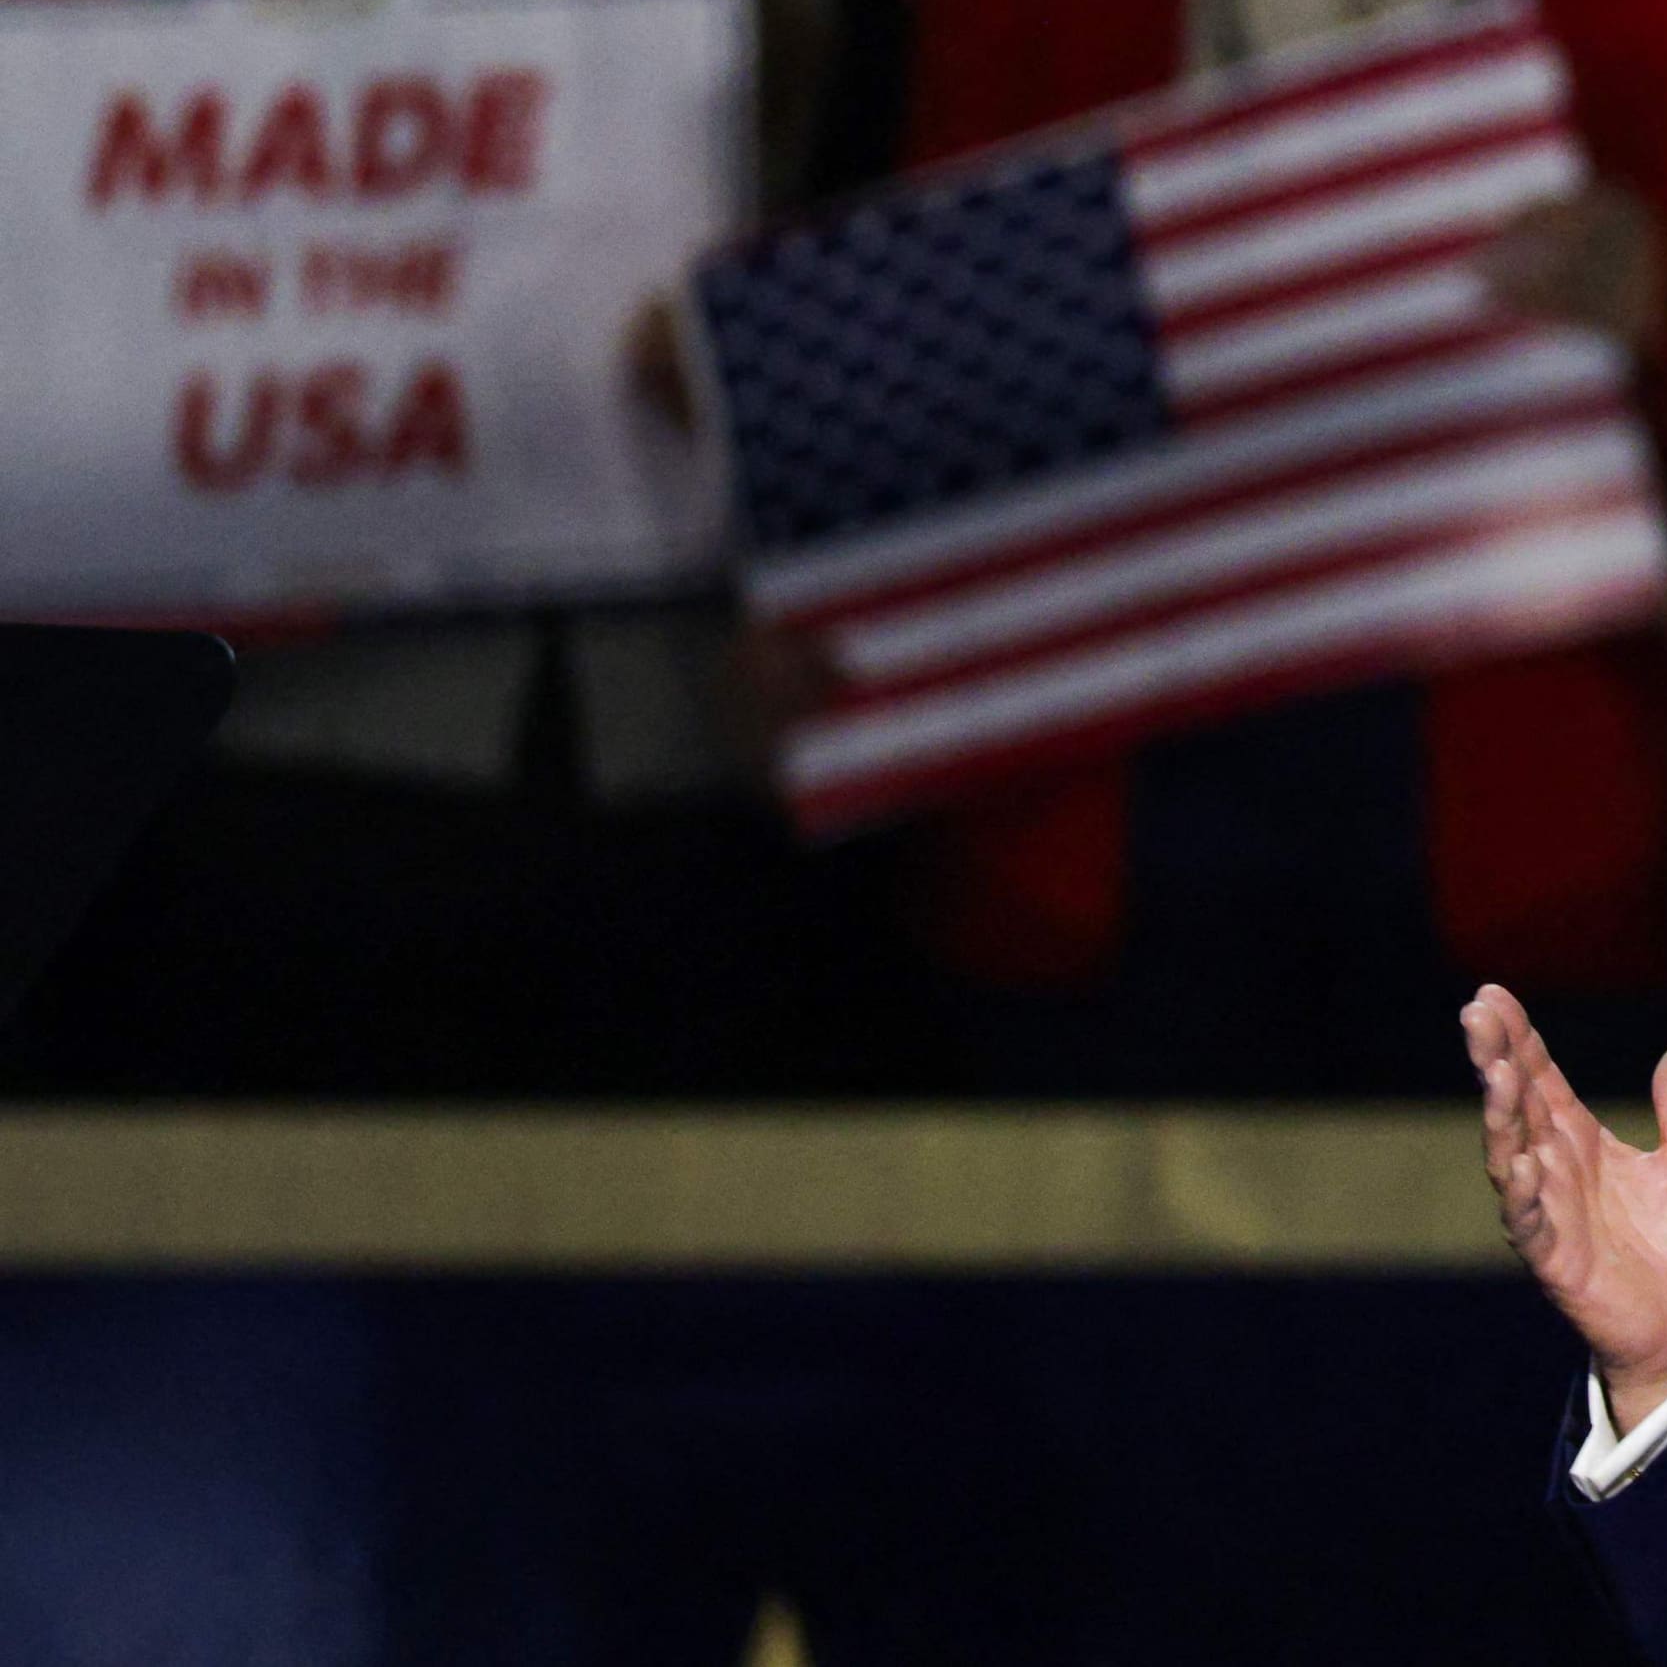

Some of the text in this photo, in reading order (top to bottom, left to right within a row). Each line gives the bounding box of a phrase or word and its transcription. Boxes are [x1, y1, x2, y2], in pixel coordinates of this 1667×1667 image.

[88, 69, 548, 211] MADE
[178, 237, 460, 319] IN THE
[174, 357, 466, 493] USA
